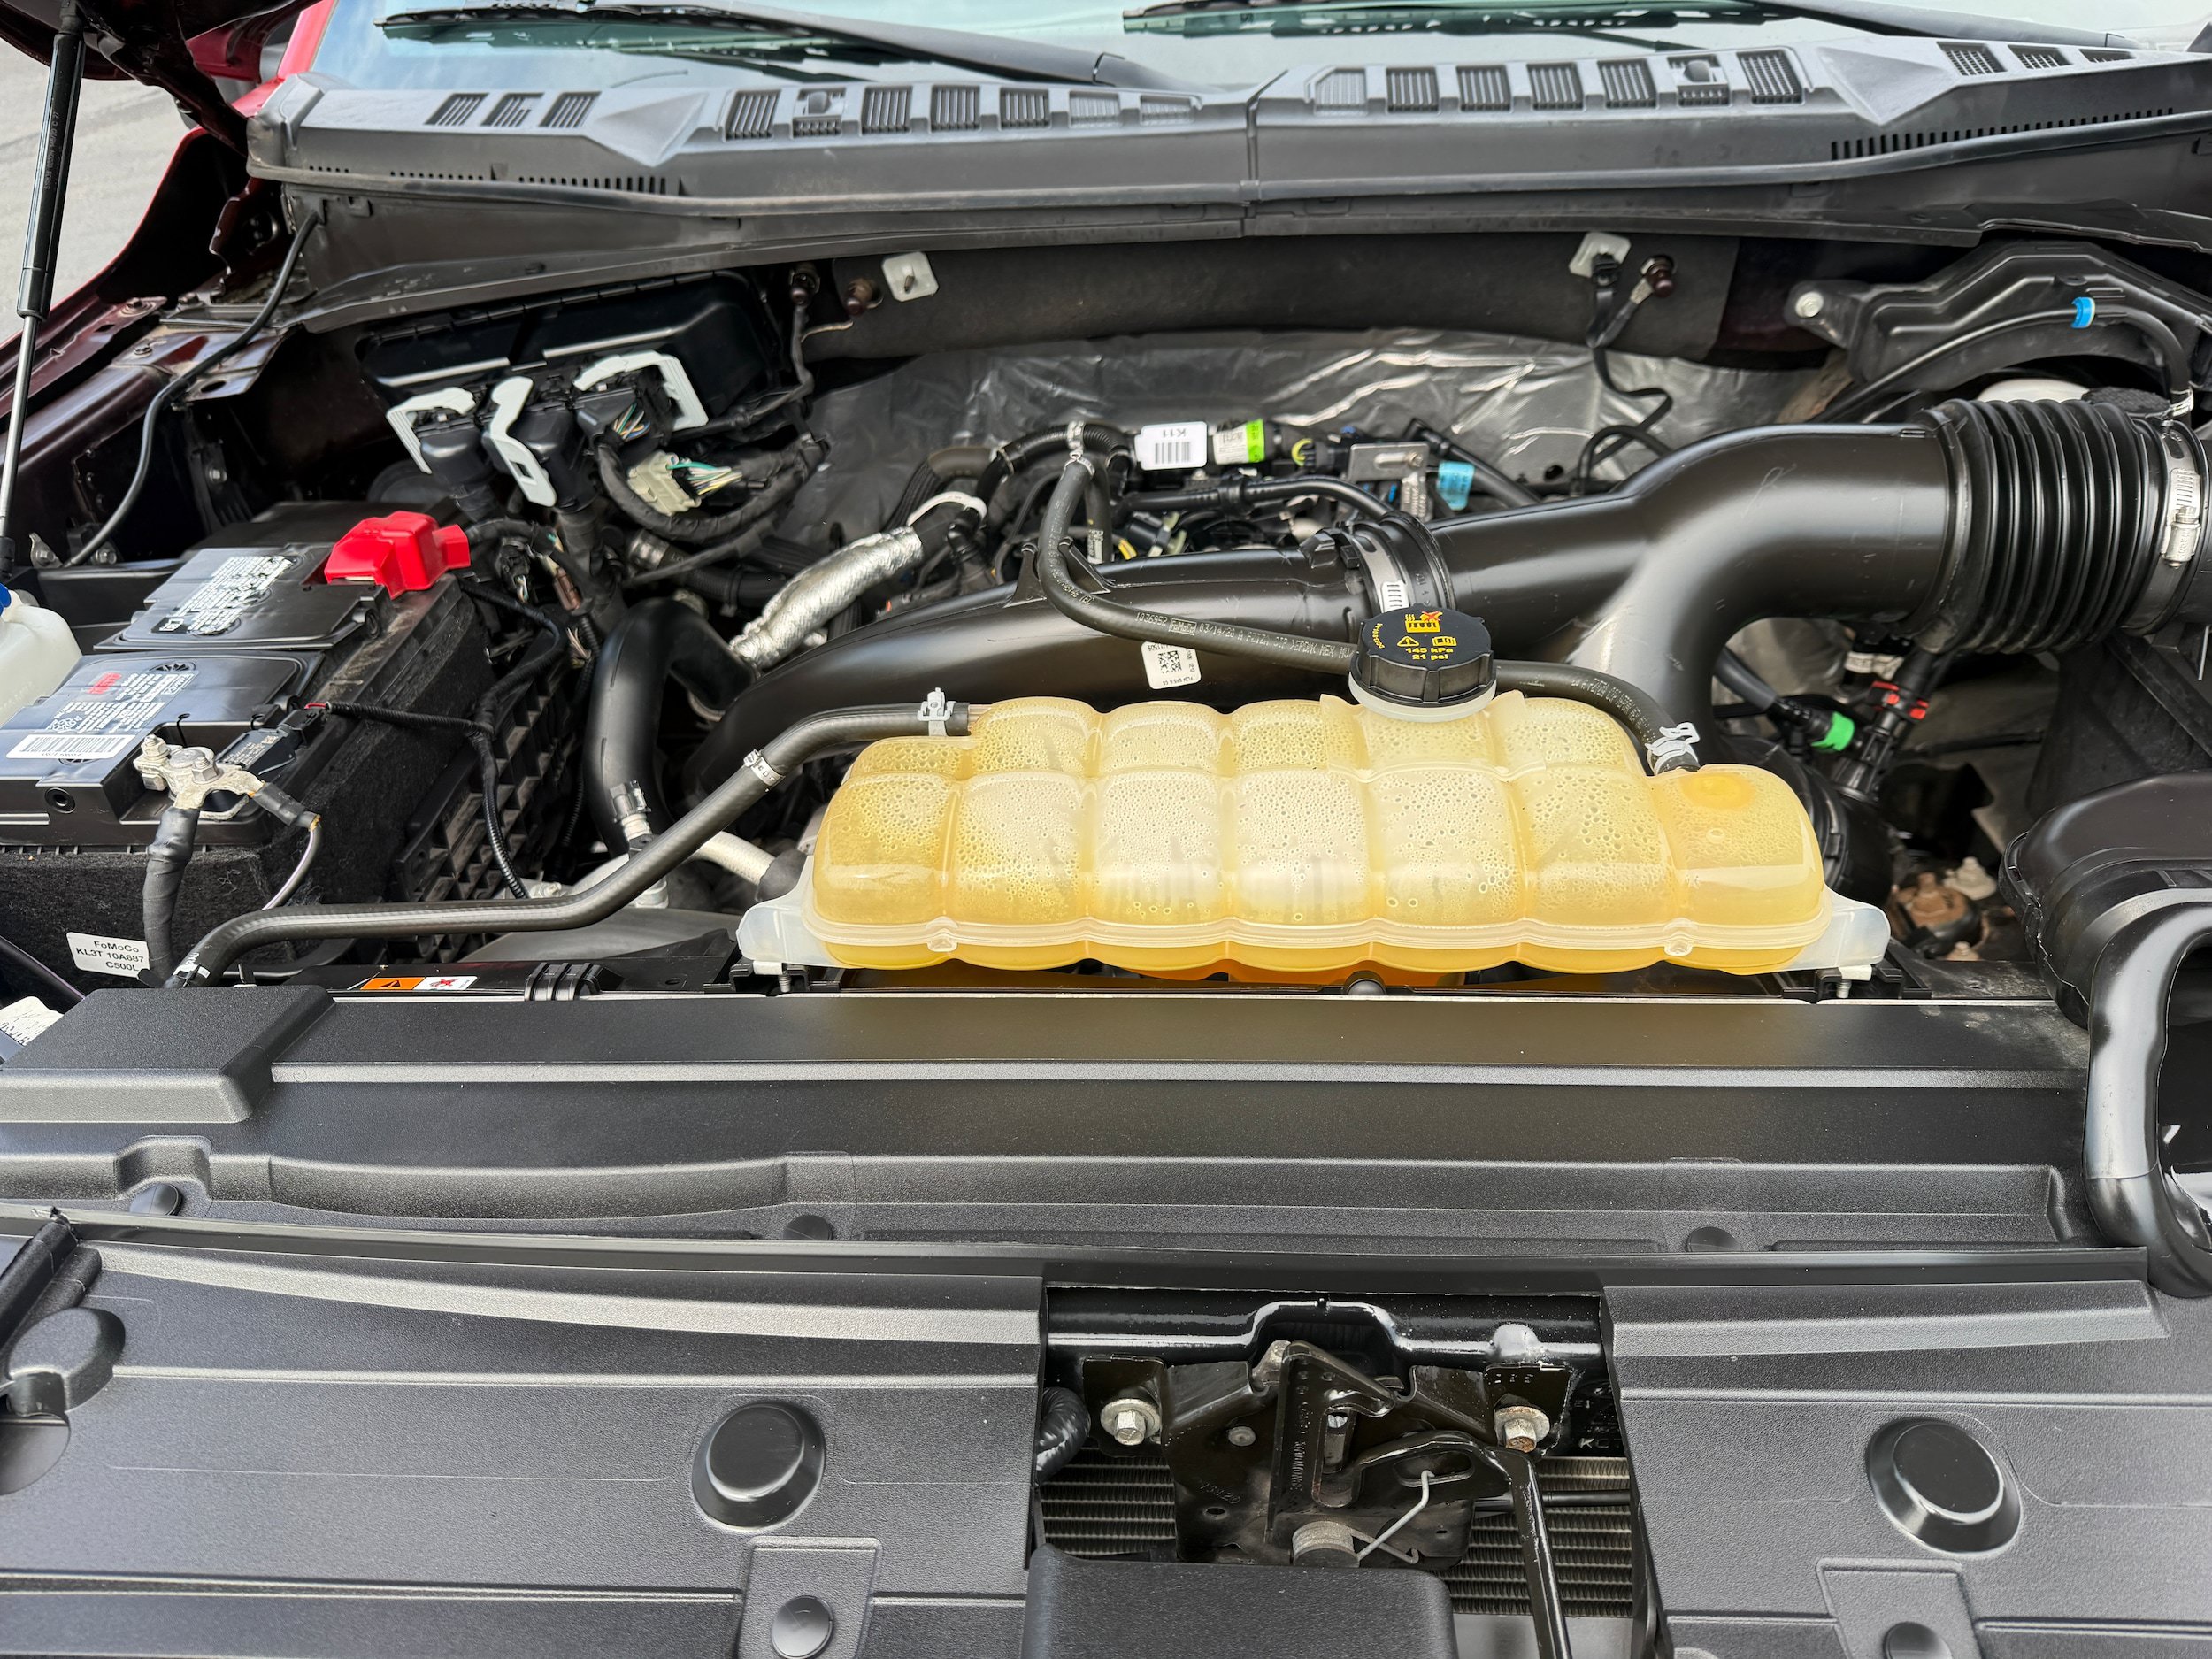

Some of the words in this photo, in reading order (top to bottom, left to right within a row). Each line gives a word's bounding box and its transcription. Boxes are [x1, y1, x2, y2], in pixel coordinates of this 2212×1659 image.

[1162, 427, 1187, 438] K11
[1134, 611, 1168, 626] 1036952
[93, 941, 140, 953] FoMoCo
[76, 947, 104, 957] KL3T
[106, 952, 144, 963] 10A687
[105, 961, 140, 972] C500L
